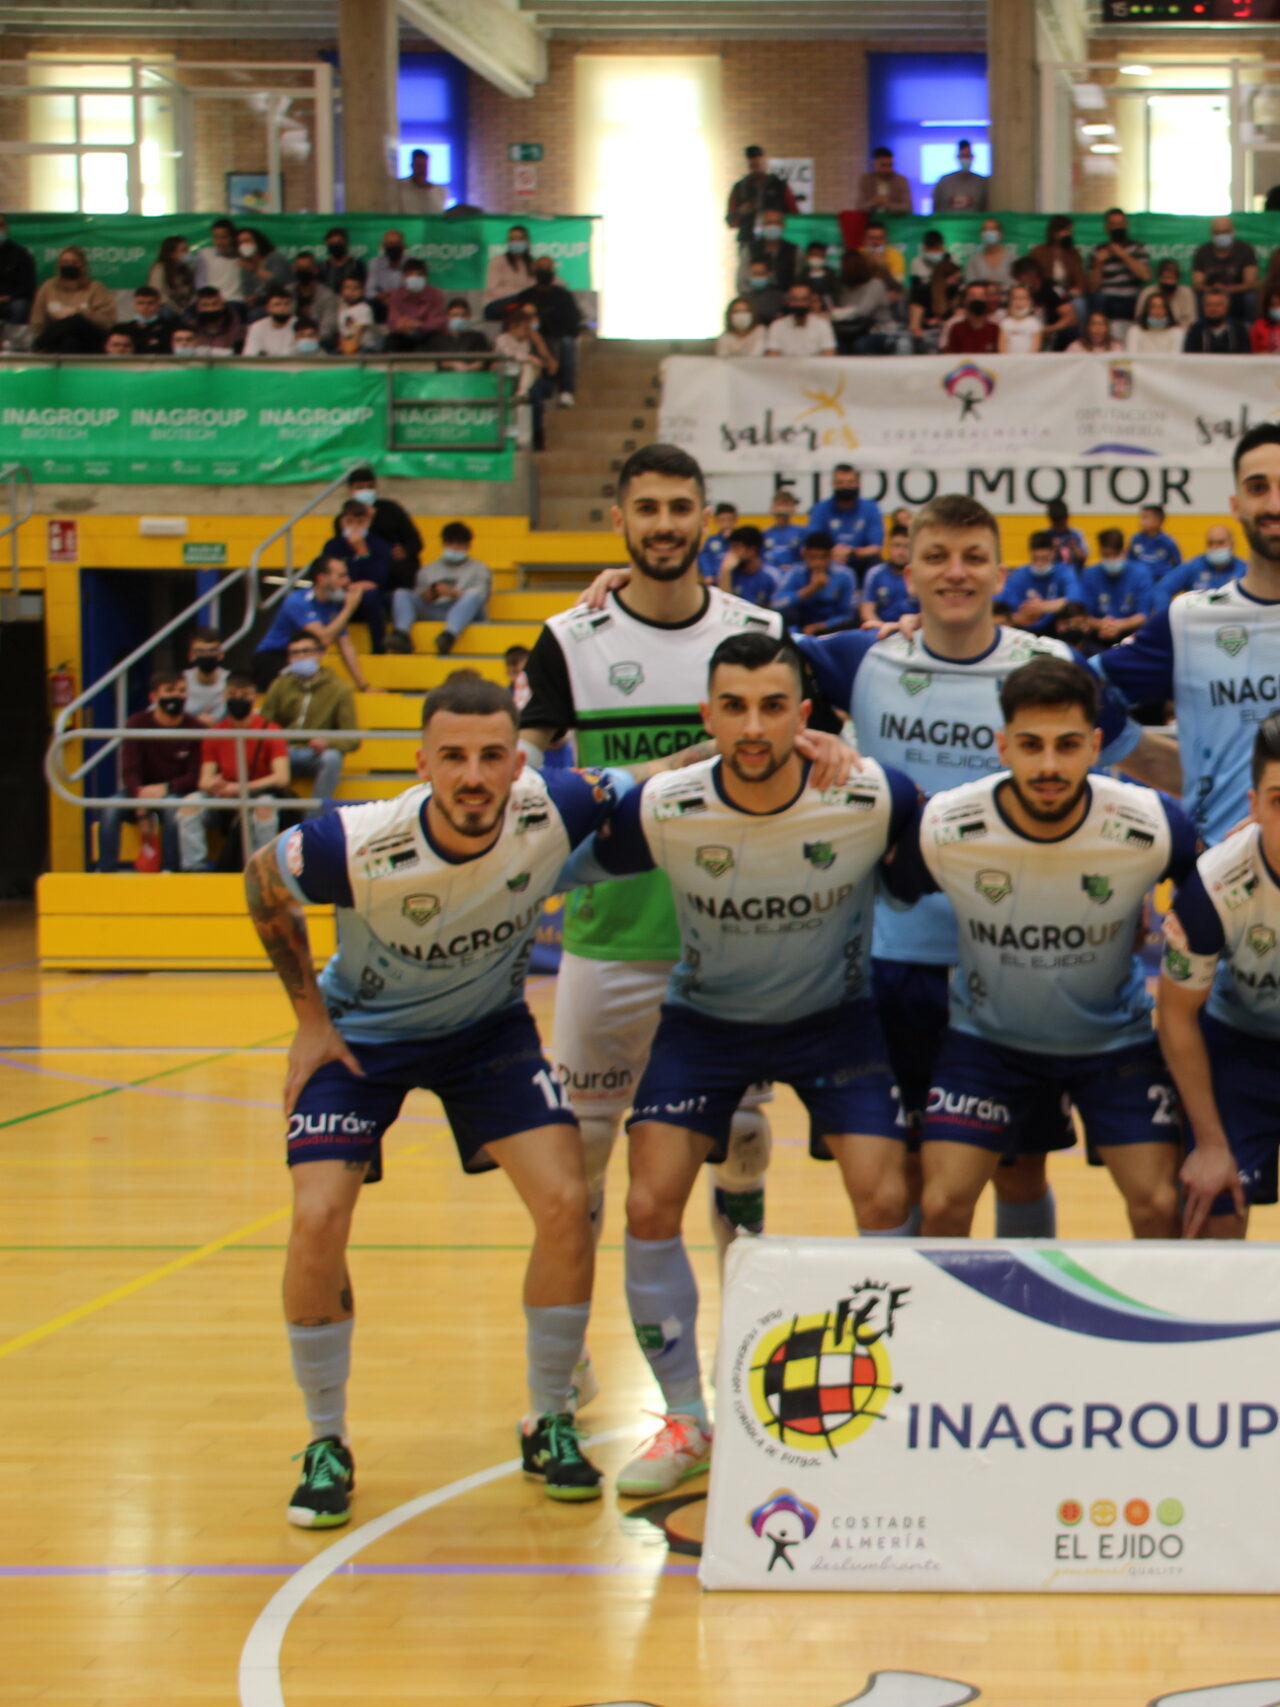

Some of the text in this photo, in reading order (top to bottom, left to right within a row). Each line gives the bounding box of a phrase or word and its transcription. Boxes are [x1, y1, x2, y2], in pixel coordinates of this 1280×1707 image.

[1, 408, 119, 426] INAGROUP
[131, 408, 248, 426] INAGROUP
[259, 407, 374, 426] INAGROUP
[393, 407, 499, 425] NAGROUP
[967, 465, 1191, 505] MOTOR
[602, 728, 712, 762] INAGR
[879, 711, 994, 750] INAGRO
[685, 883, 854, 921] INAGROUP
[968, 917, 1126, 953] INAGROUP
[925, 1087, 1011, 1124] Durán
[907, 1402, 1279, 1450] INAGROUP
[1055, 1533, 1185, 1560] EL EJIDO
